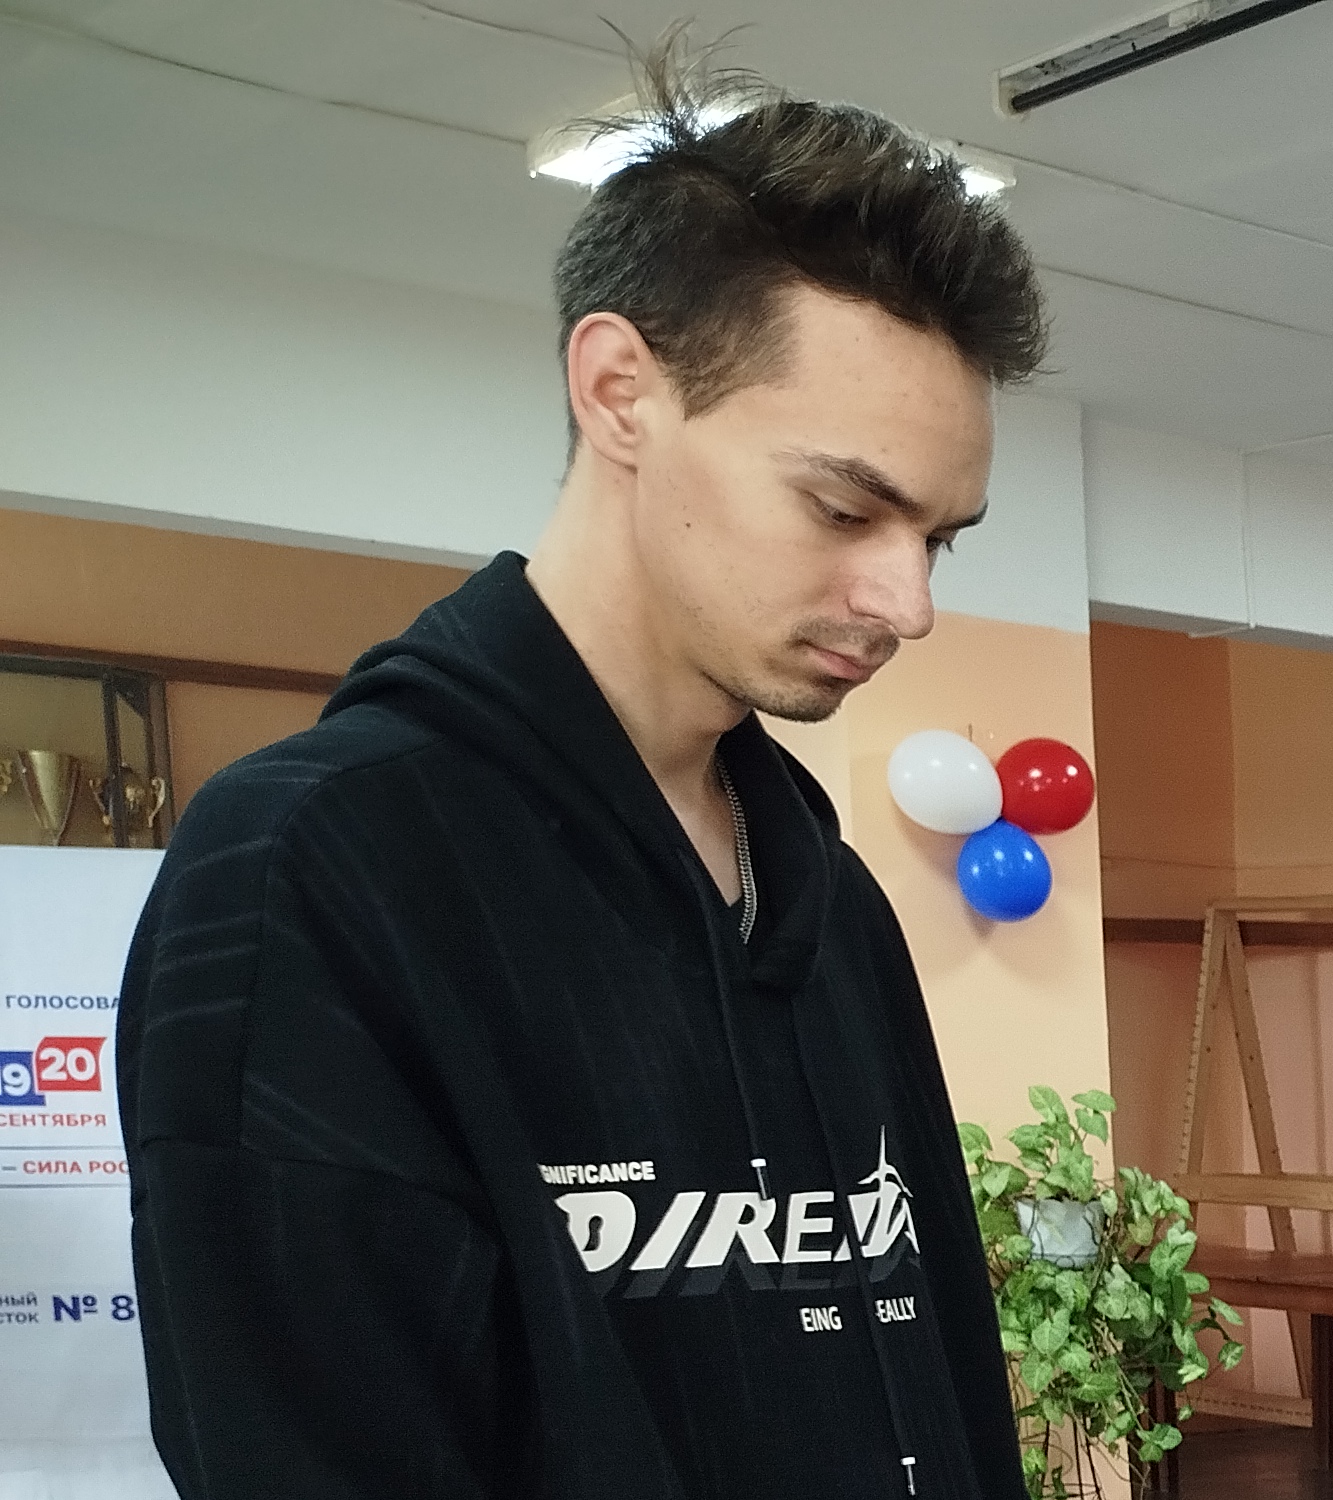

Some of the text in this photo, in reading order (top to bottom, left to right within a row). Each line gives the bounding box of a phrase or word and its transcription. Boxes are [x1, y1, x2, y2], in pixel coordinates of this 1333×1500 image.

[0, 1046, 97, 1097] 9 20
[23, 1160, 82, 1175] СИЛА
[53, 1295, 135, 1321] № 8
[875, 1296, 917, 1323] EALLY
